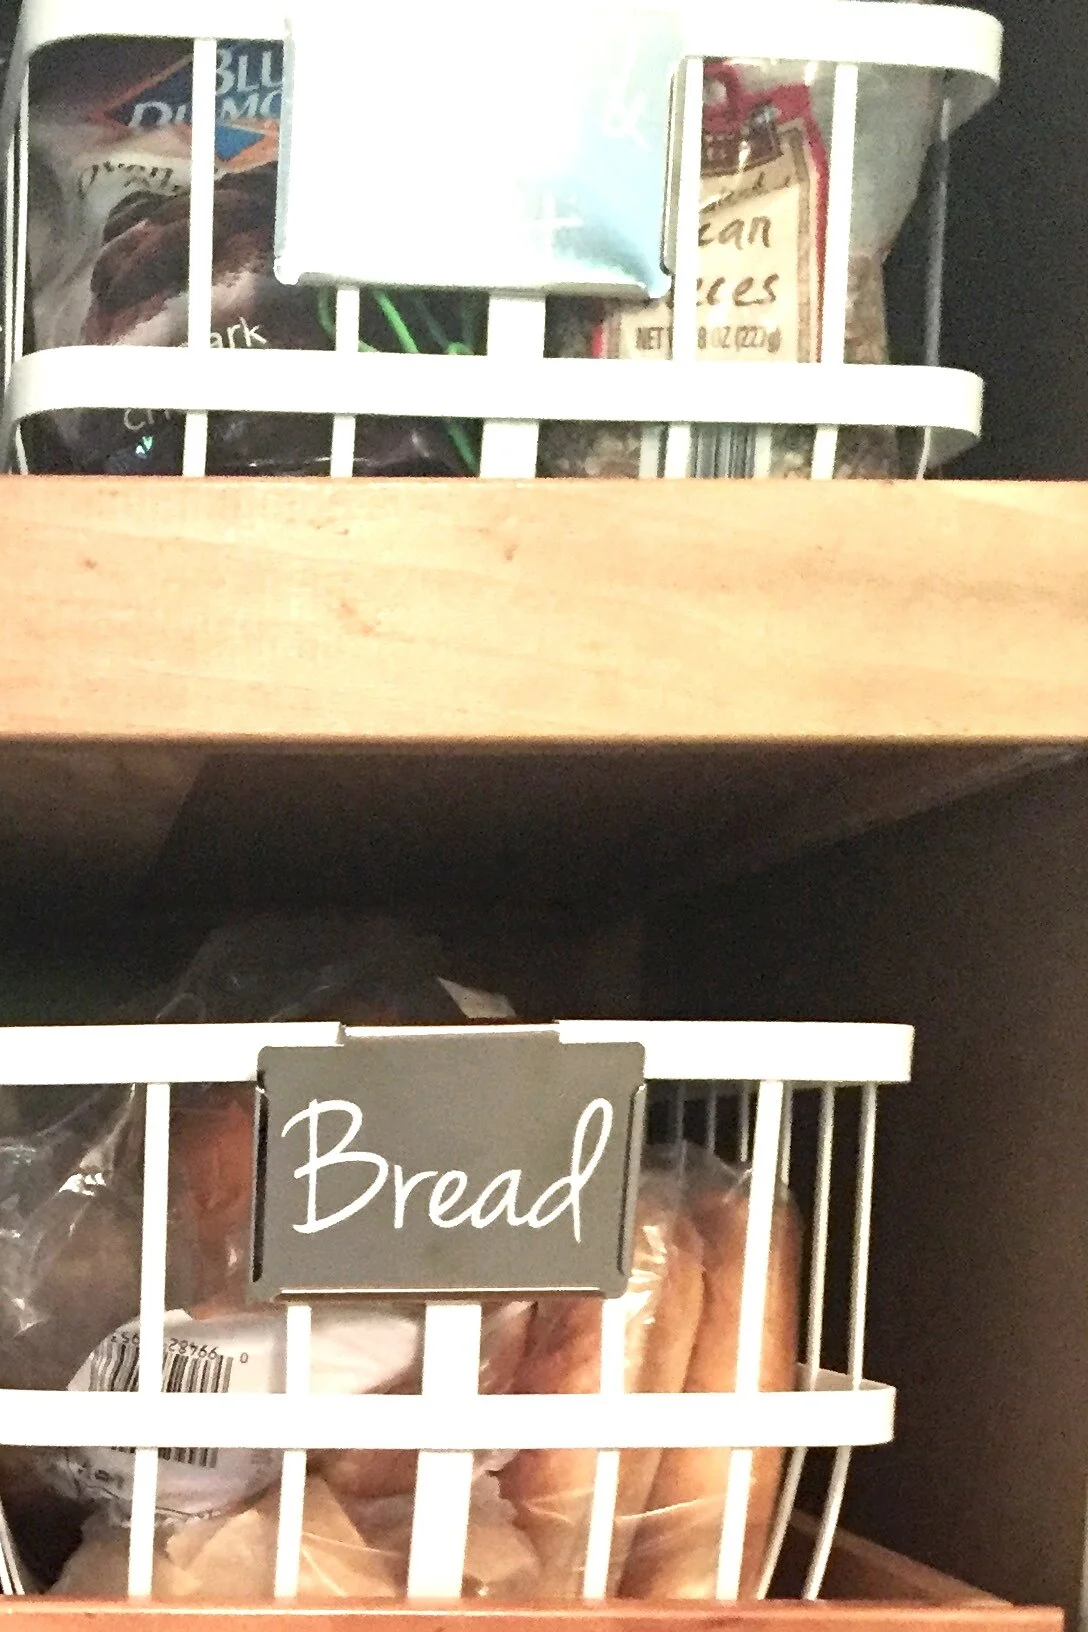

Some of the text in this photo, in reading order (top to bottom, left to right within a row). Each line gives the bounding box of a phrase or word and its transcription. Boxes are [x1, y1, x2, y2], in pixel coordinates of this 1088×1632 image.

[696, 272, 779, 306] ces
[210, 317, 268, 348] ark
[281, 1097, 614, 1243] Bread
